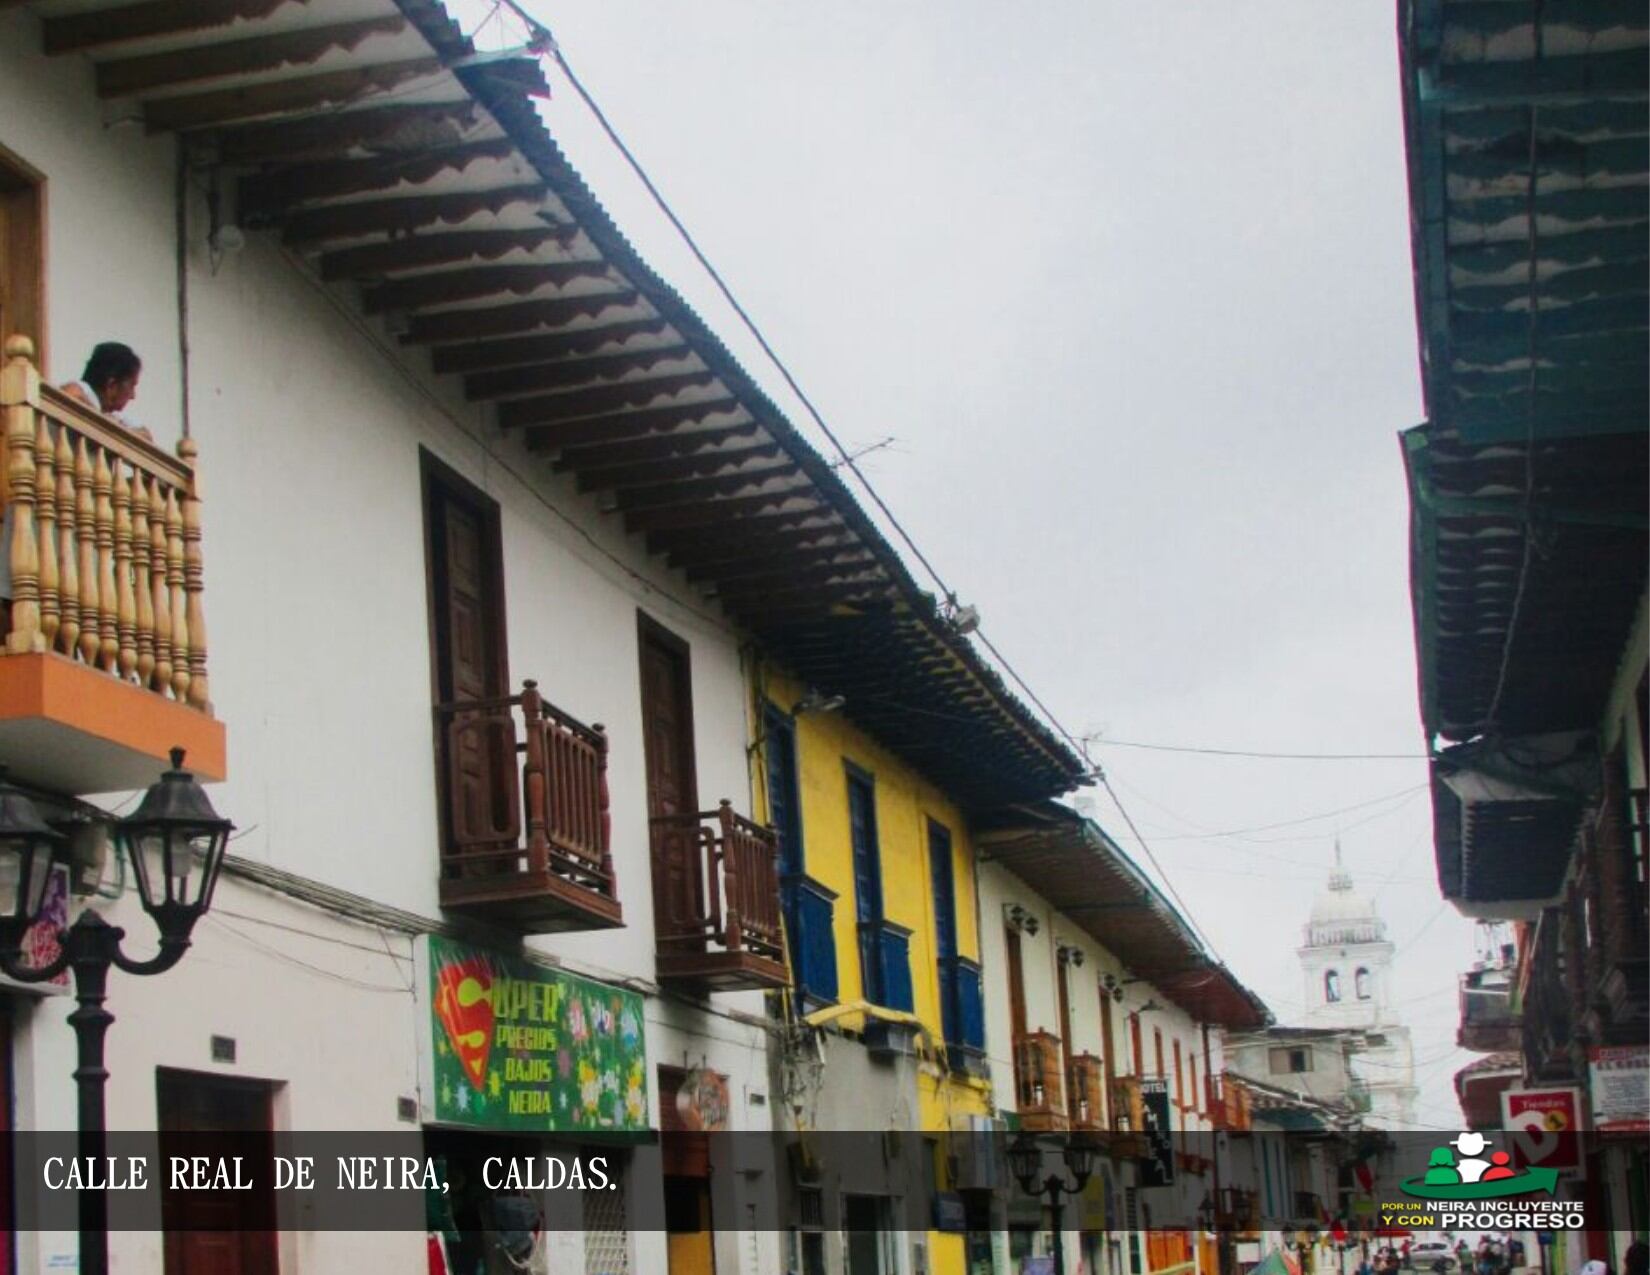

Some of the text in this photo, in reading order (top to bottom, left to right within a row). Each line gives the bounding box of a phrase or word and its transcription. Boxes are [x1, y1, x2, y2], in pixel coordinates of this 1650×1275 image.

[496, 1024, 558, 1052] PRECIOS
[504, 1057, 554, 1083] BAJOS
[508, 1089, 553, 1114] NEIRA
[1521, 1099, 1566, 1109] Tiendas
